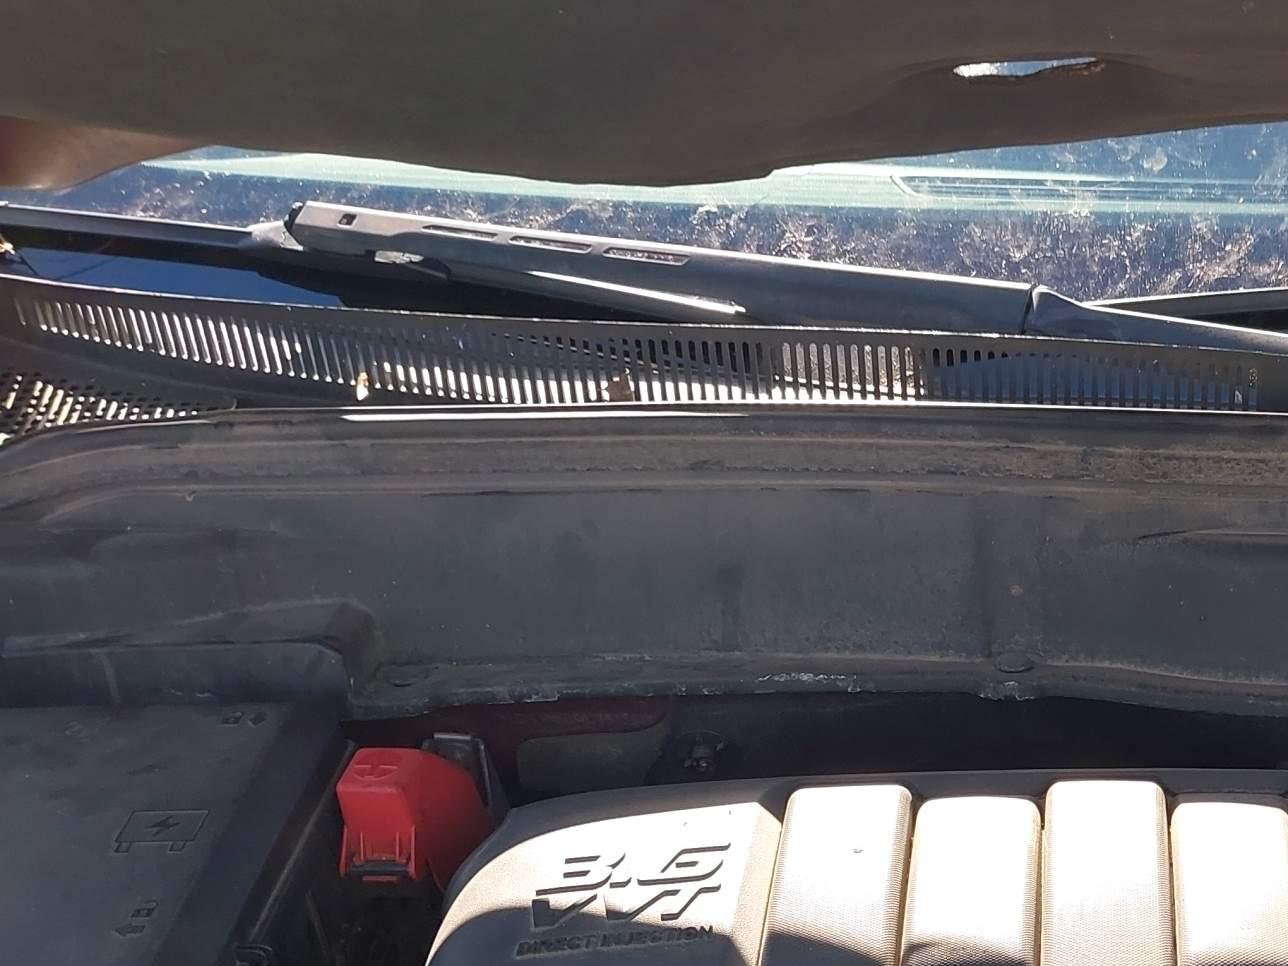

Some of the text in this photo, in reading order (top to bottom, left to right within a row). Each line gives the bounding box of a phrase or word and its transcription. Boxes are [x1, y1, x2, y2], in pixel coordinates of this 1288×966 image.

[535, 841, 732, 896] 3.6
[529, 882, 722, 930] VVT
[515, 924, 714, 958] DIRECT INJECTION
